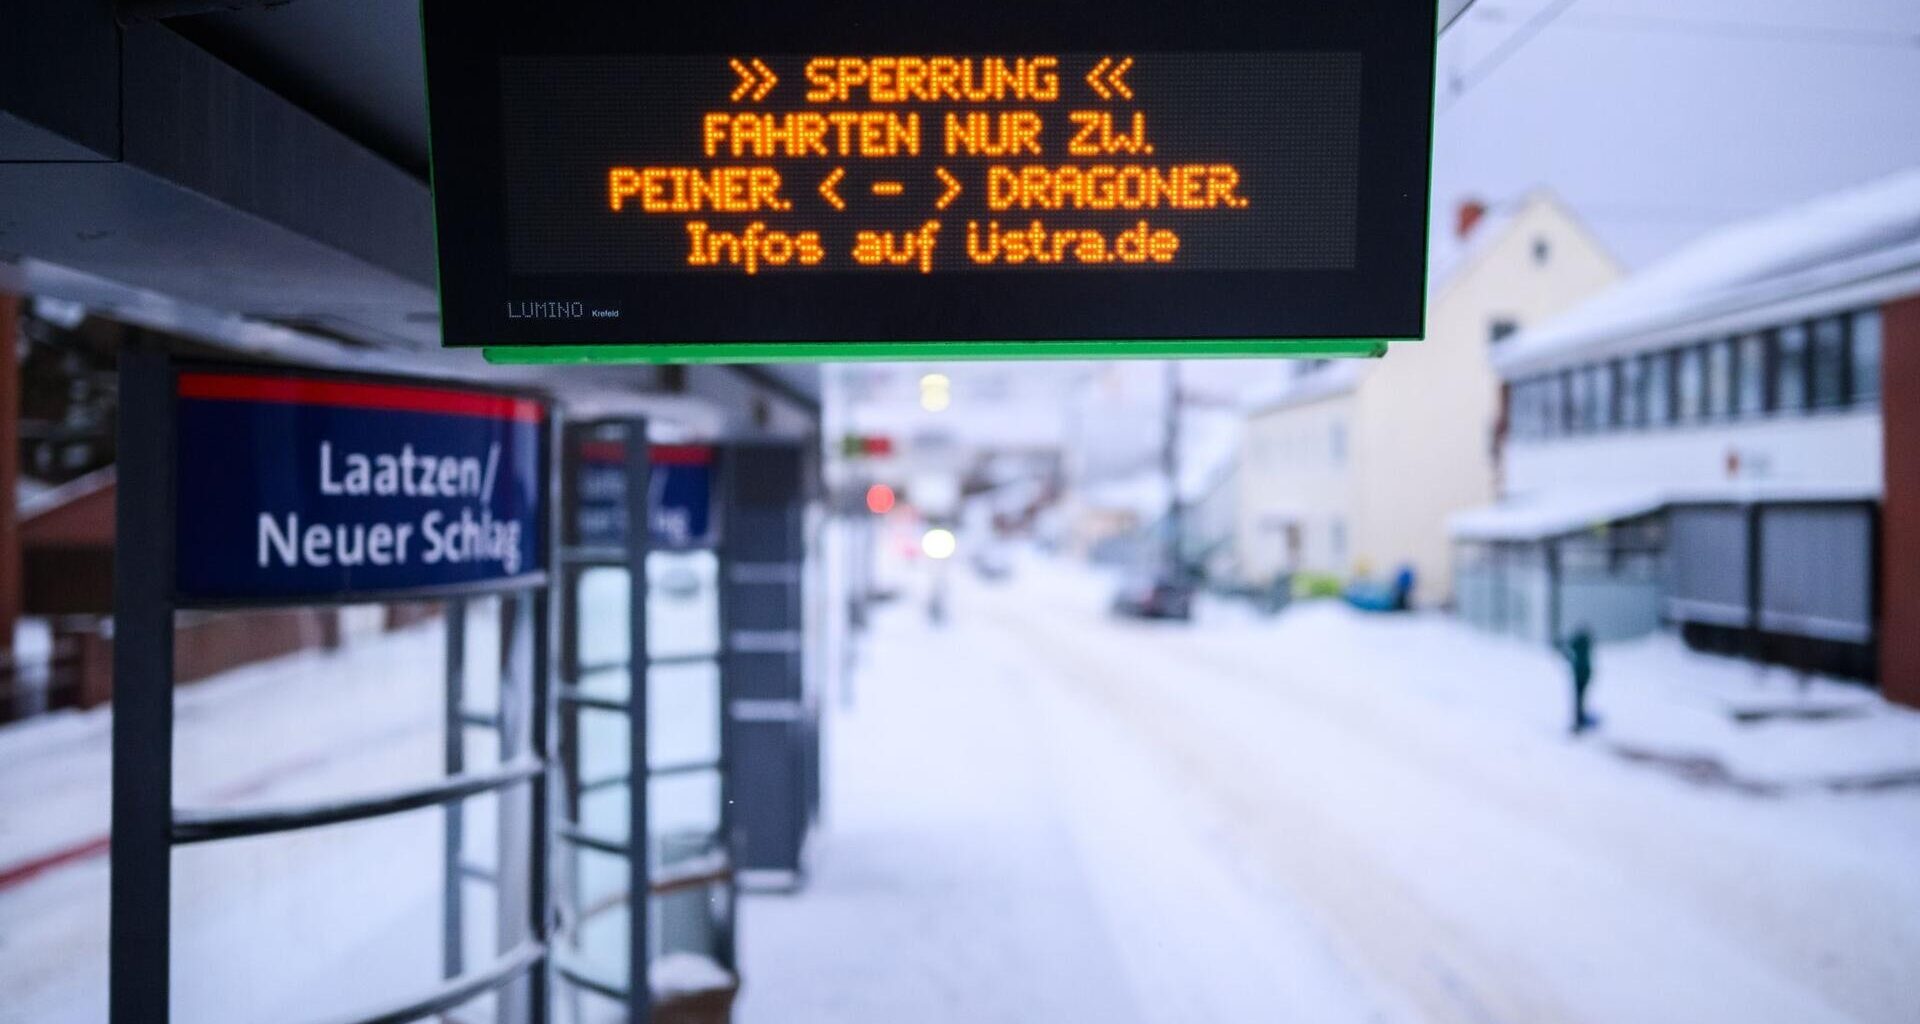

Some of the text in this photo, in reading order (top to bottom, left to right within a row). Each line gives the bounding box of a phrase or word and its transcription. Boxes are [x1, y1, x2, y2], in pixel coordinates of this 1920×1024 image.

[805, 56, 1059, 103] SPERRUNG
[704, 110, 1154, 157] FAHRTEN NUR ZW.
[609, 166, 793, 212] PEINER.
[987, 164, 1249, 211] DRAGONER.
[686, 221, 825, 274] Infos
[852, 220, 941, 274] auf
[507, 302, 619, 318] LUMINO Krefeld
[319, 441, 500, 505] Laatzen/
[256, 508, 521, 573] Neuer Schlag
